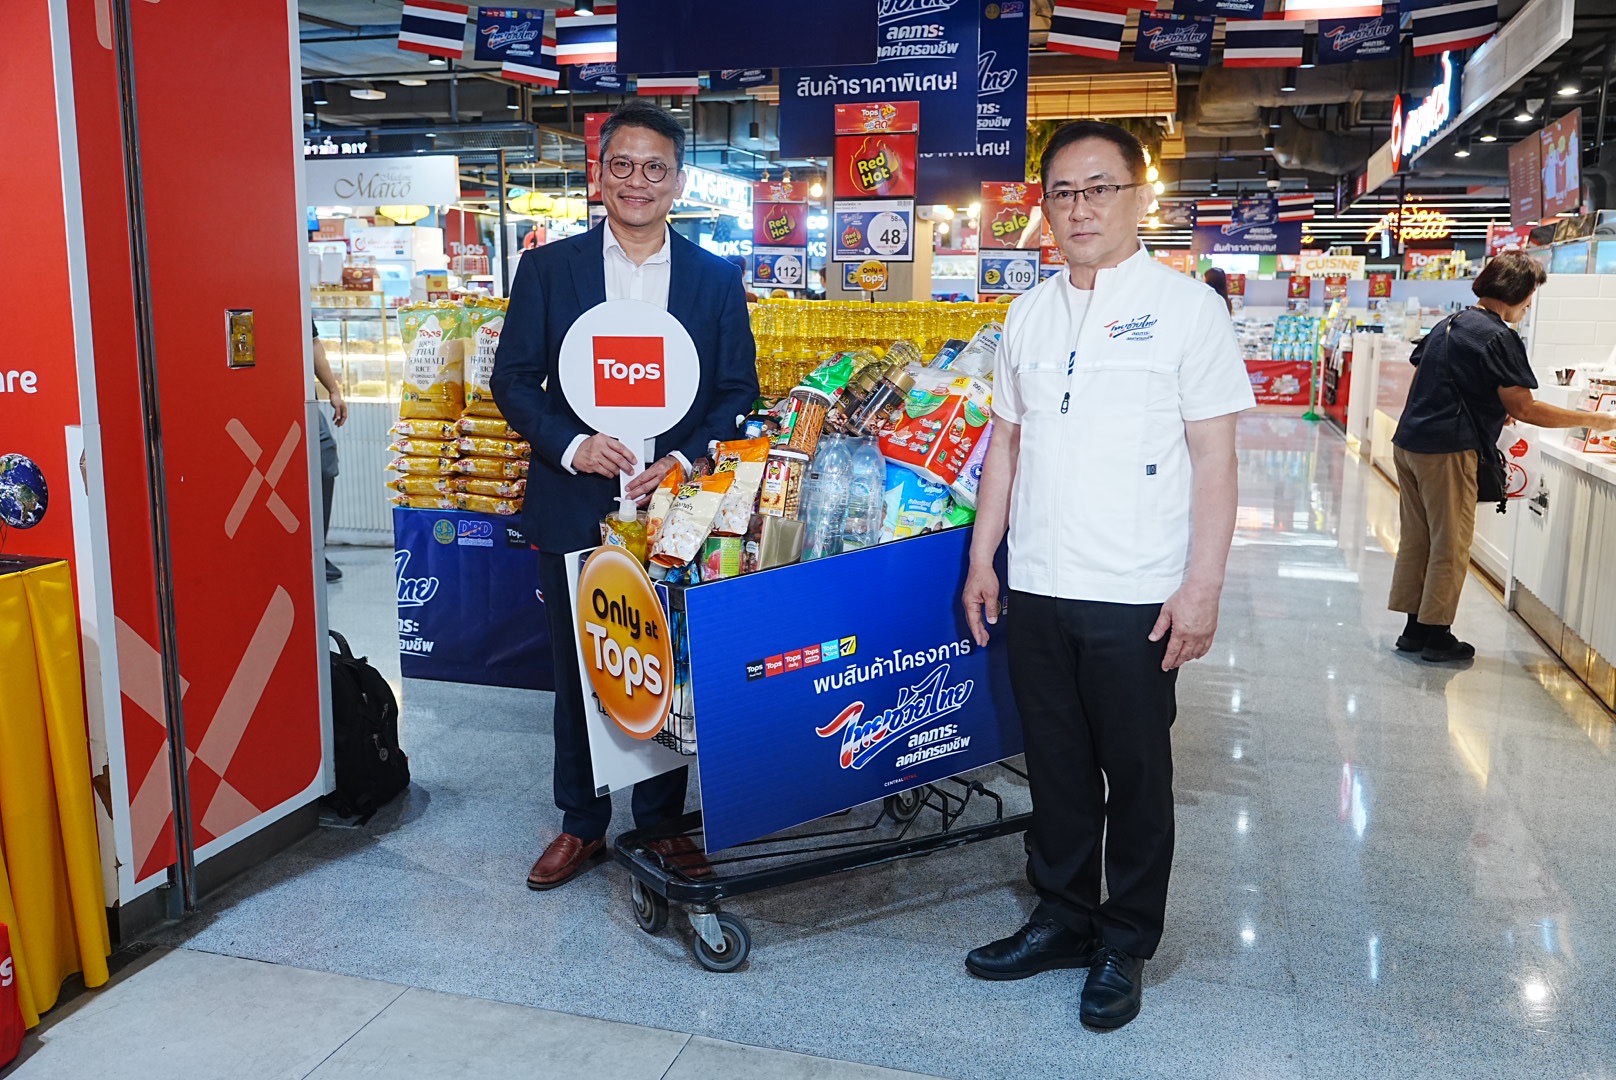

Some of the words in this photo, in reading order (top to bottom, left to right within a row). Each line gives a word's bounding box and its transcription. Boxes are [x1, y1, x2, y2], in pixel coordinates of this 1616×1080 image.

[886, 24, 945, 40] ลดภาระ
[796, 71, 958, 97] สินค้าราคาพิเศษ!
[858, 152, 885, 173] Red
[862, 167, 890, 187] Hot
[768, 216, 787, 230] Red
[992, 214, 1029, 237] Sale
[771, 227, 790, 239] Hot
[880, 229, 901, 245] 48
[450, 242, 483, 256] Tops
[863, 267, 878, 275] Only
[1306, 259, 1360, 271] CUISINE
[777, 267, 797, 278] 112
[861, 274, 884, 284] Tops
[1009, 271, 1031, 283] 109
[481, 326, 499, 339] Top
[478, 346, 496, 355] THA
[597, 359, 661, 385] Tops
[0, 369, 39, 394] re
[458, 520, 493, 537] DBD
[592, 588, 641, 640] Only
[645, 620, 659, 640] at
[804, 648, 819, 656] Tops
[823, 644, 838, 652] Tops
[585, 621, 663, 697] Tops
[766, 660, 783, 670] Tops
[785, 655, 801, 663] Tops
[746, 664, 763, 673] Tops
[813, 639, 971, 695] พบสินค้าโครงการ
[907, 723, 958, 748] ลดภาระ
[895, 736, 971, 768] ลดค่าครองชีพ
